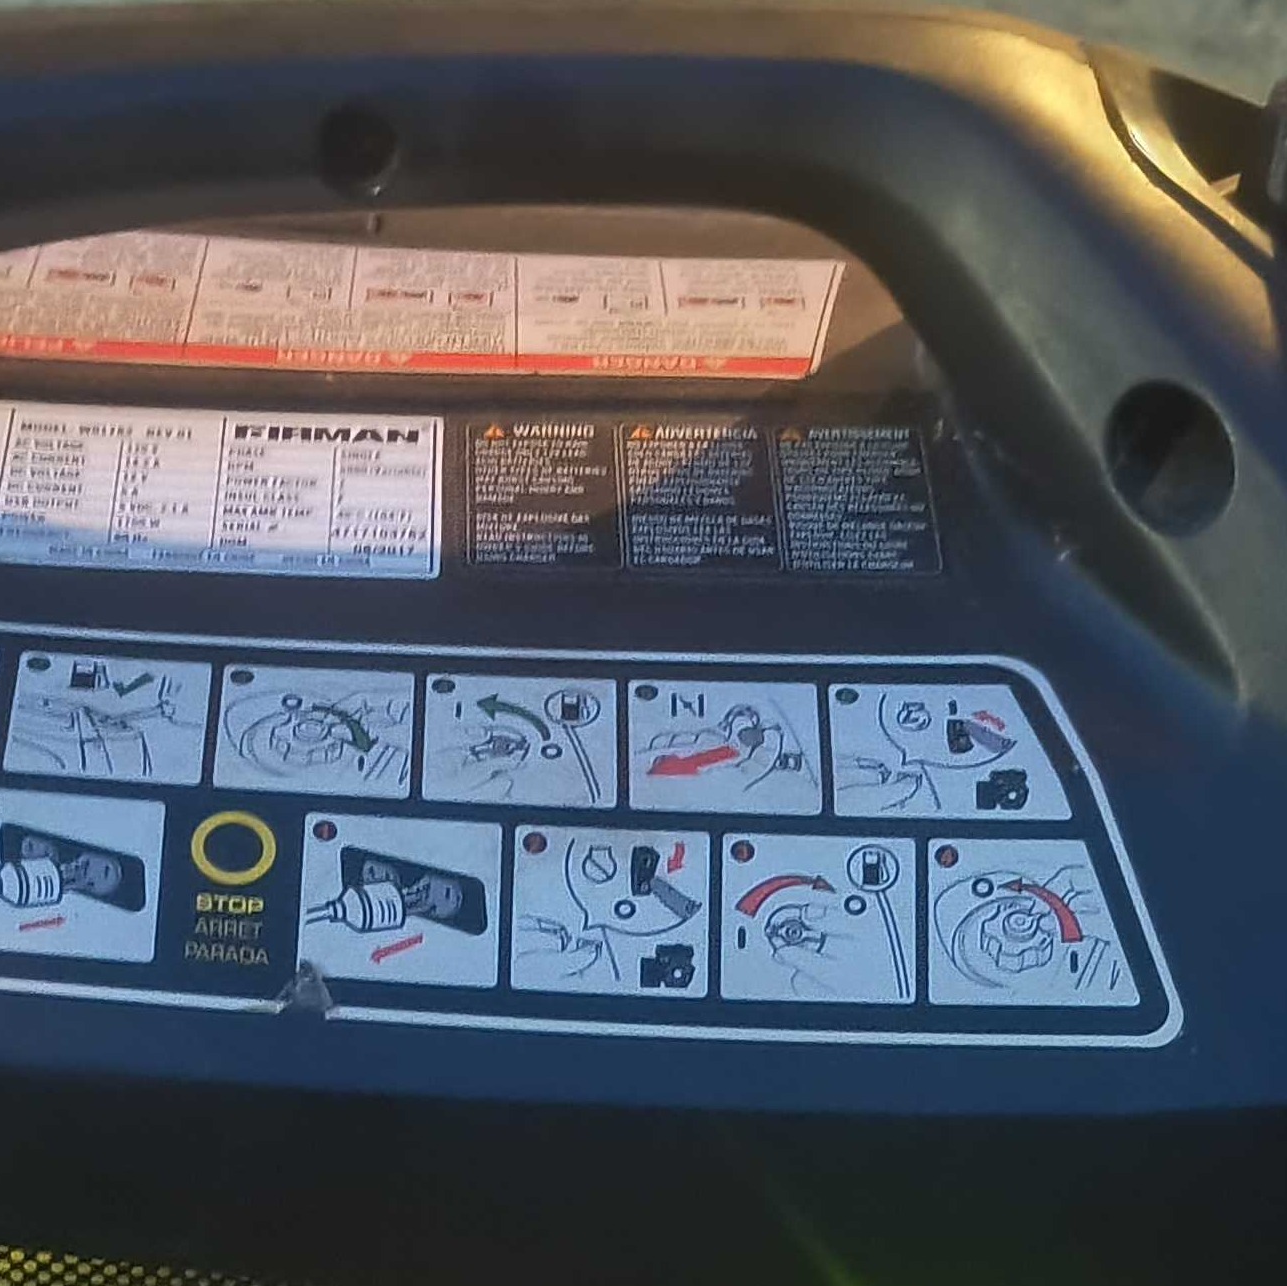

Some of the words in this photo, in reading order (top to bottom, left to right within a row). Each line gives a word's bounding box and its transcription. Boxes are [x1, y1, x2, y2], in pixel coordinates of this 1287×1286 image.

[233, 425, 420, 444] FIRMAN
[196, 892, 264, 915] STOP
[184, 940, 269, 966] PARADA
